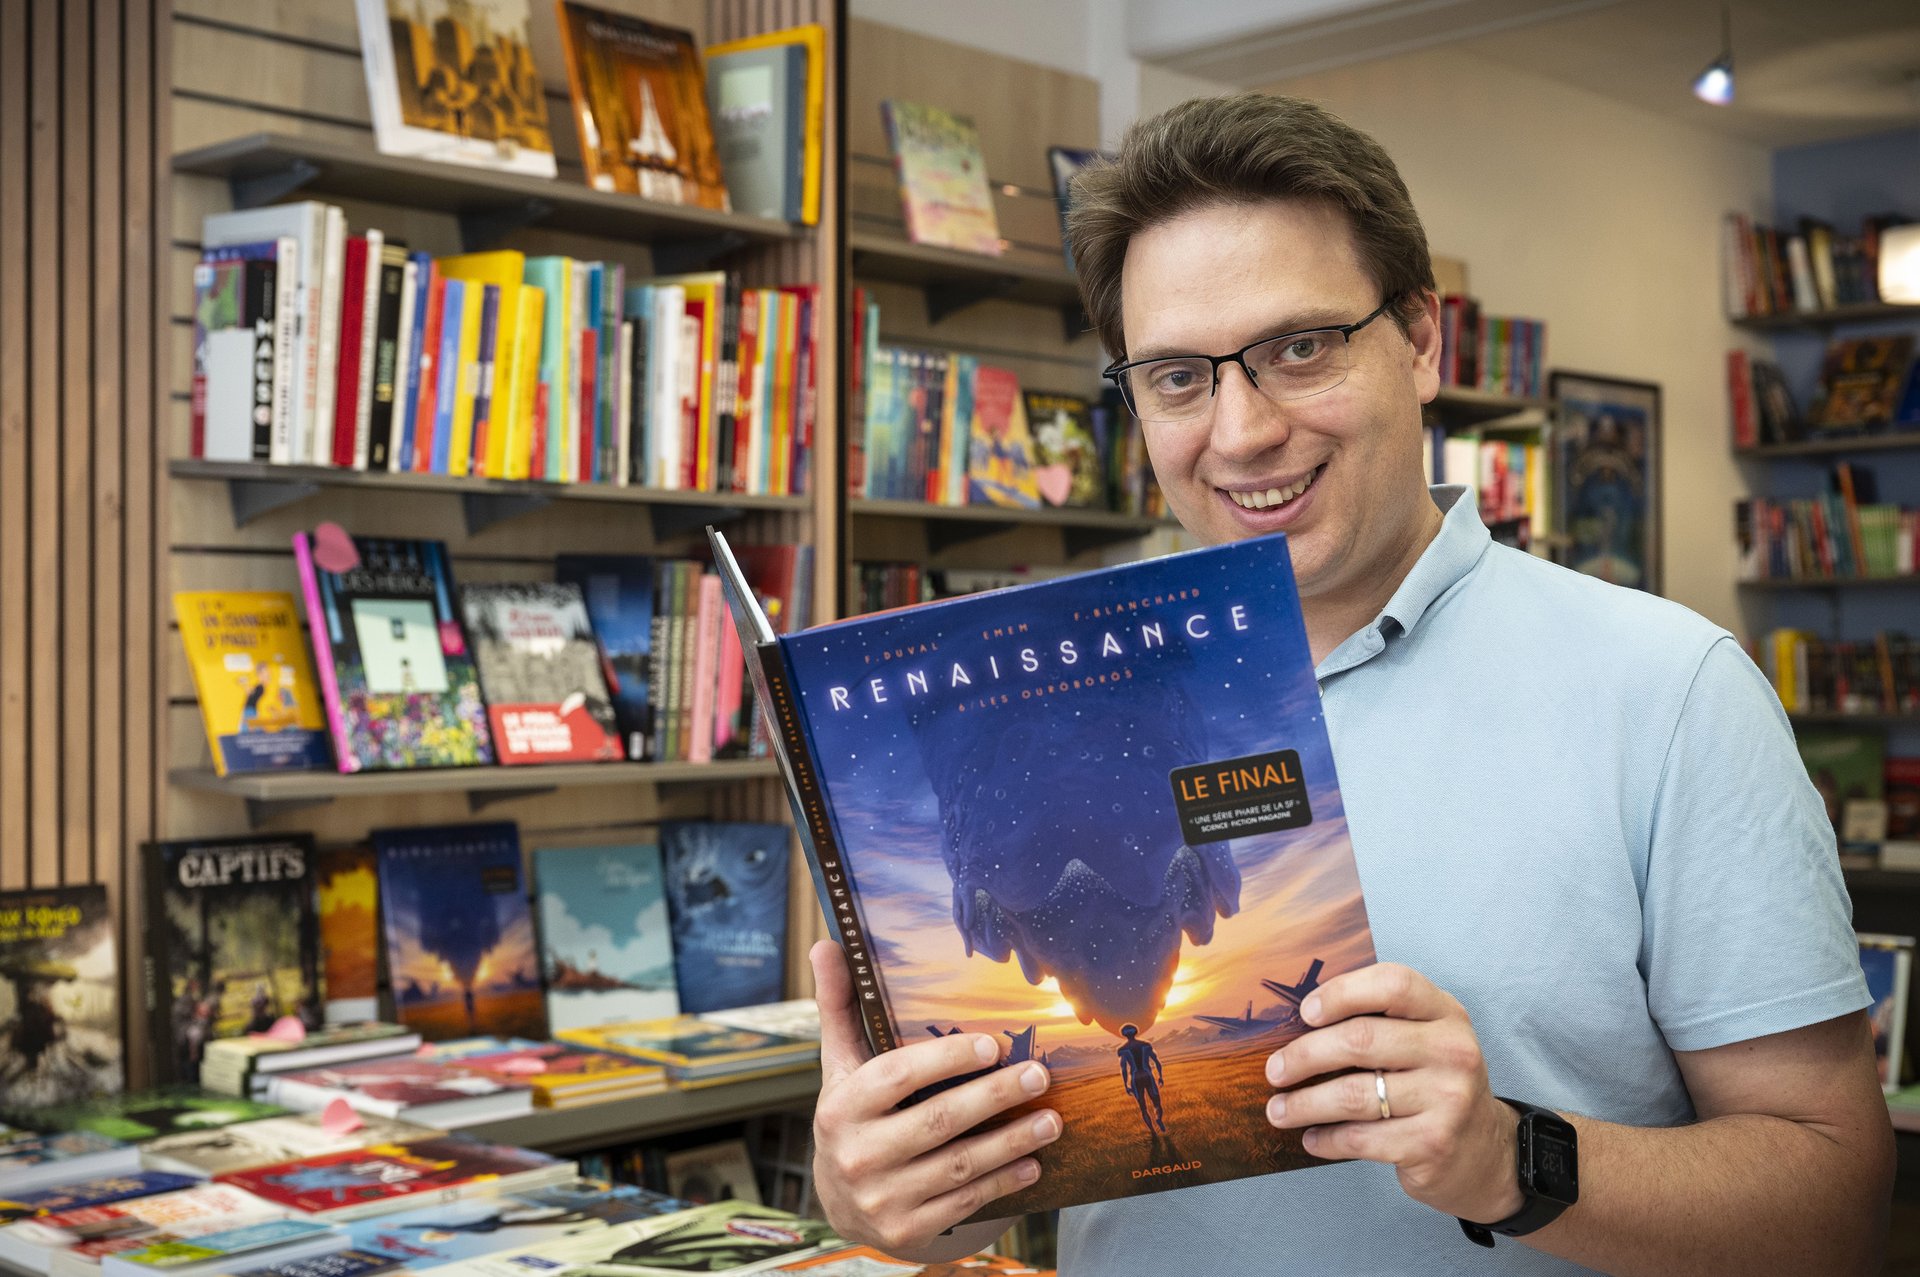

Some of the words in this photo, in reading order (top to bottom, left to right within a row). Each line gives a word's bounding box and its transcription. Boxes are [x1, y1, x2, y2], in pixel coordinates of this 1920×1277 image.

[864, 642, 938, 665] F.DUVAL
[982, 623, 1029, 640] EMEM
[1073, 587, 1200, 621] F.BLANCHARD
[829, 605, 1248, 711] RENAISSANCE
[1021, 668, 1133, 699] OUROBOROS
[1180, 776, 1210, 801] LE
[1217, 761, 1296, 795] FINAL
[1234, 806, 1260, 818] PHARE
[1261, 803, 1271, 813] DE
[1273, 801, 1285, 811] LA
[1257, 811, 1291, 823] MAGAZINE
[178, 850, 306, 888] CAPTIFS
[826, 860, 876, 1001] RENAISSANCE
[1131, 1160, 1203, 1179] DARGAUD
